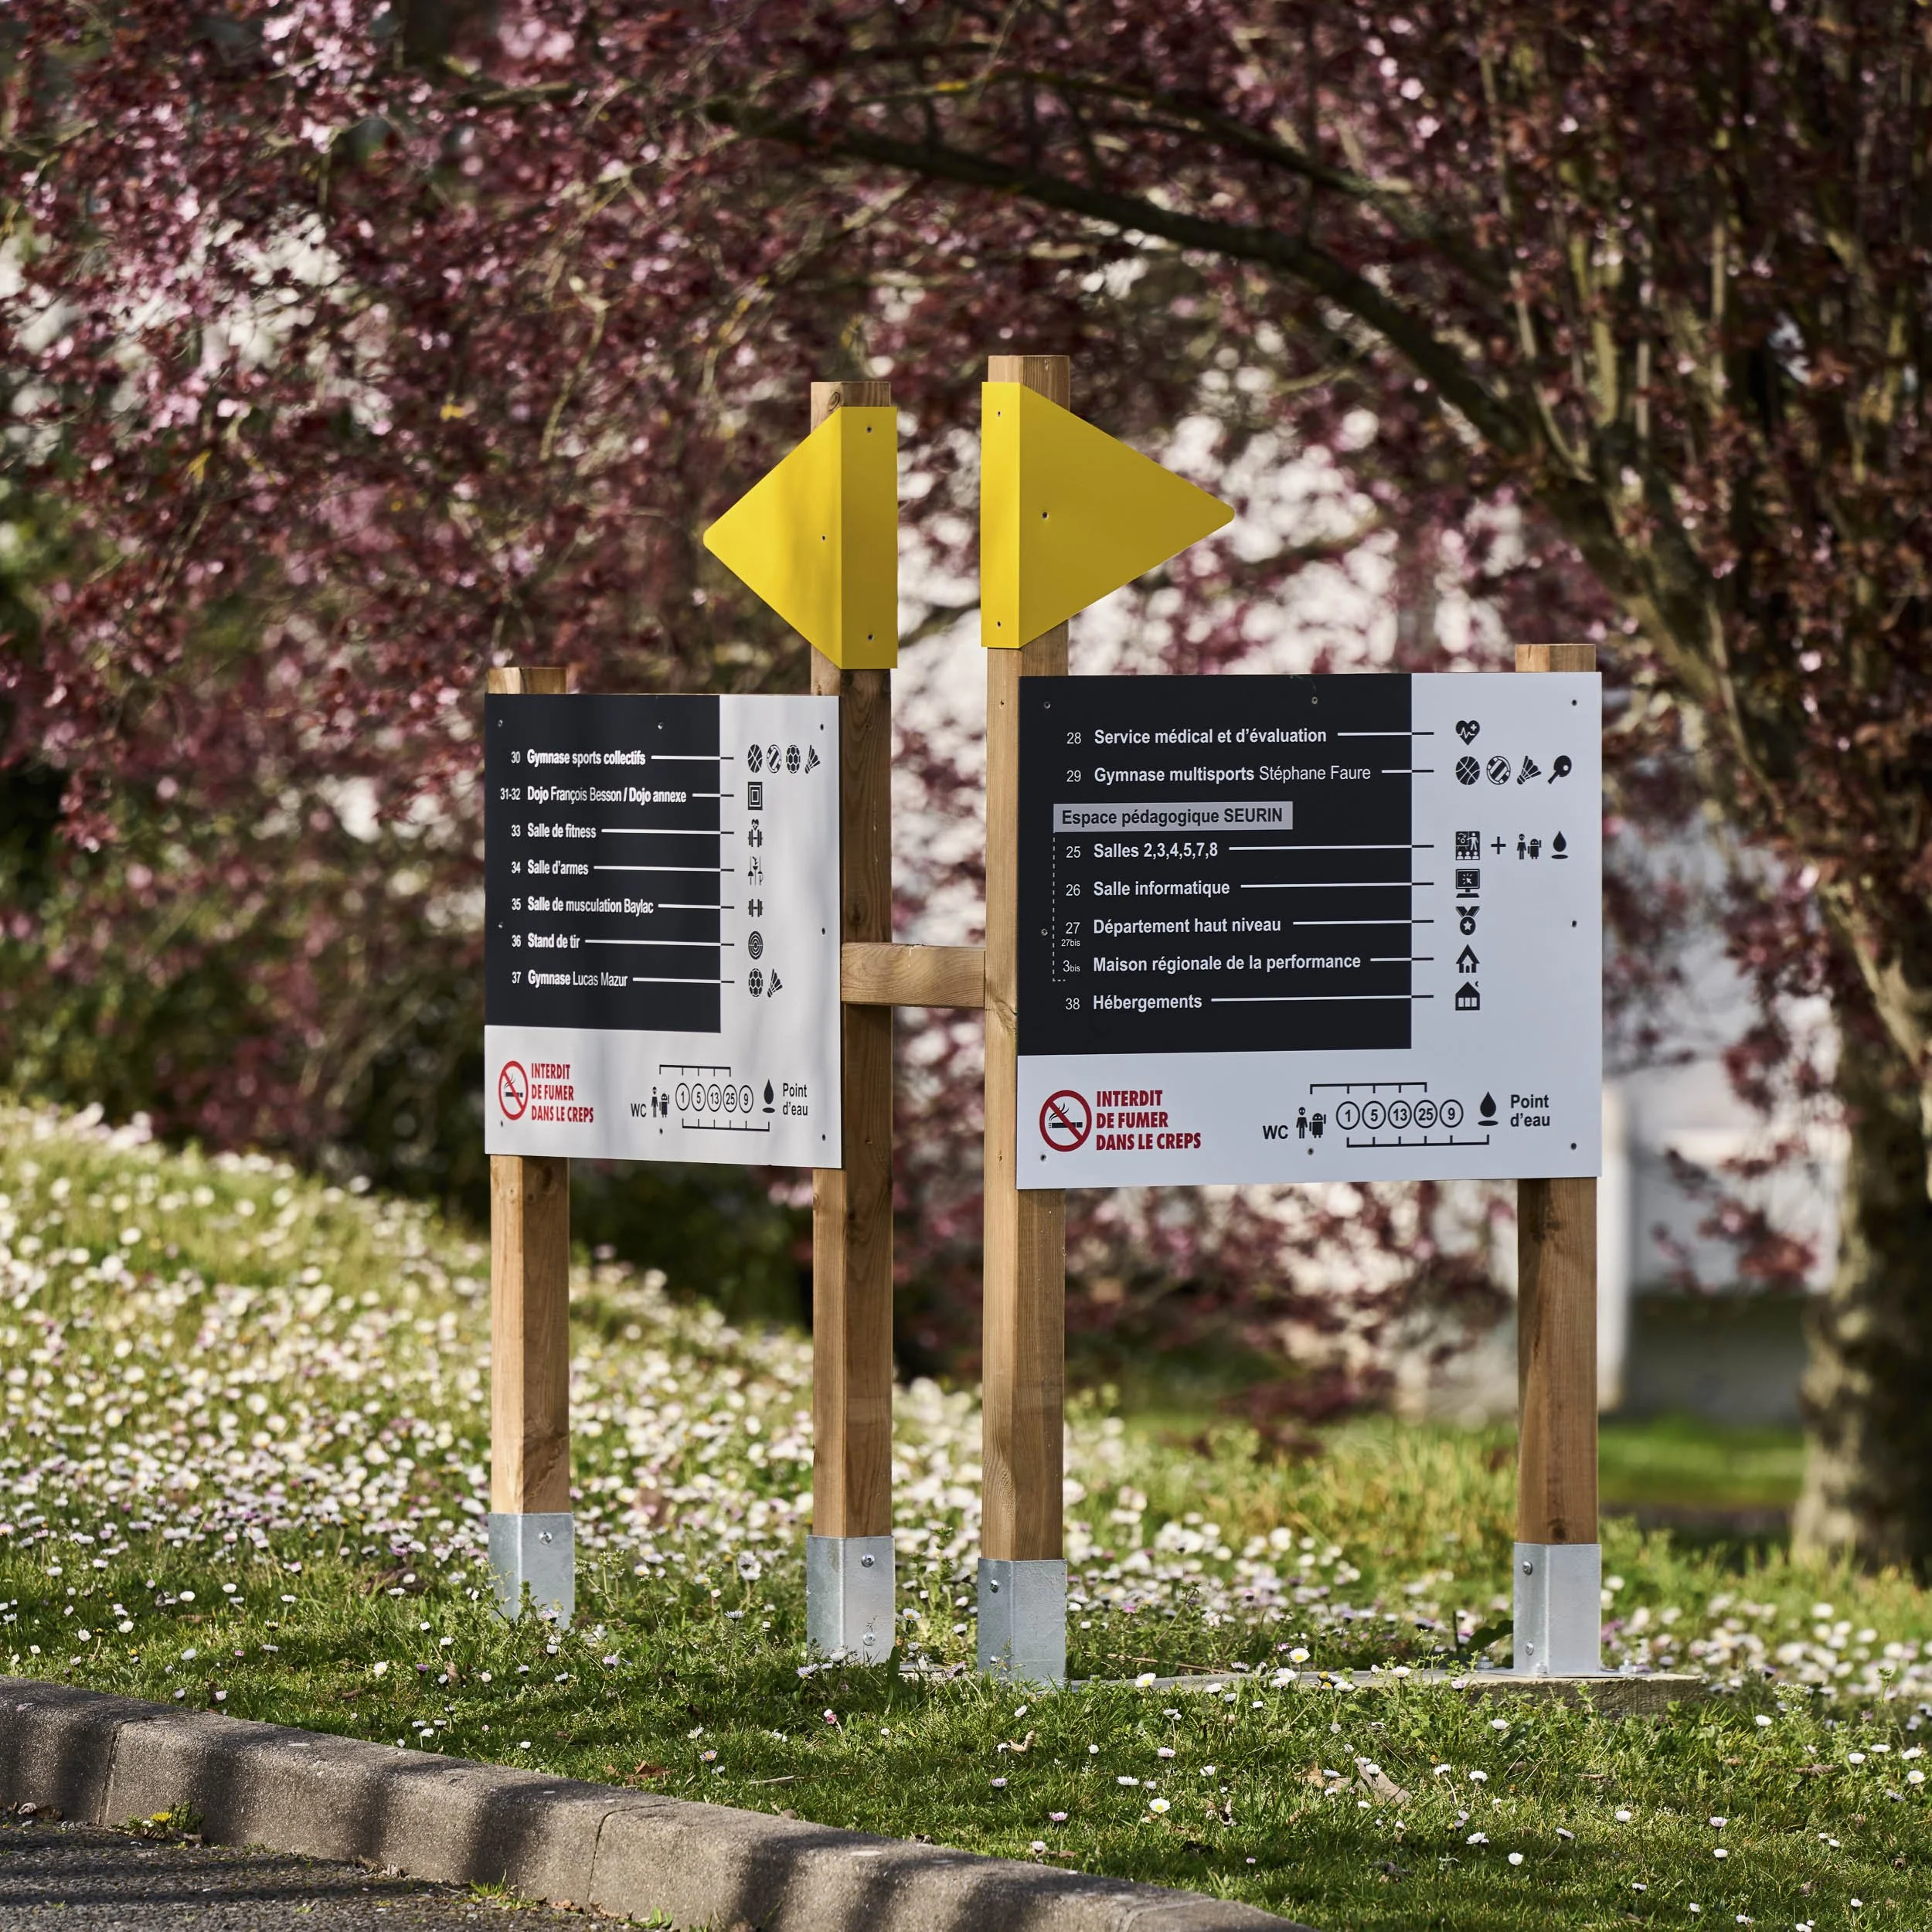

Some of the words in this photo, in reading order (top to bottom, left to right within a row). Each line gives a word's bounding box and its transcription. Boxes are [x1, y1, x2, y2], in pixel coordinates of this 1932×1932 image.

[1066, 732, 1082, 744] 28
[1094, 729, 1151, 744] Service
[1155, 728, 1213, 743] médical
[1217, 729, 1232, 743] et
[511, 750, 521, 764] 30
[526, 748, 570, 768] Gymnase
[571, 750, 602, 768] sports
[603, 750, 646, 766] collectifs
[1066, 770, 1081, 783] 29
[1094, 767, 1165, 786] Gymnase
[1169, 766, 1255, 784] multisports
[1259, 765, 1326, 784] Stéphane
[1331, 765, 1371, 780] Faure
[500, 787, 521, 801] 31-32
[527, 785, 549, 804] Dojo
[550, 785, 588, 804] François
[589, 787, 622, 802] Besson
[623, 787, 628, 802] /
[628, 787, 651, 806] Dojo
[652, 791, 687, 803] annexe
[1062, 809, 1117, 828] Espace
[1121, 808, 1219, 828] pédagogique
[1223, 808, 1283, 823] SEURIN
[511, 824, 521, 838] 33
[527, 822, 550, 838] Salle
[551, 823, 564, 838] de
[564, 822, 597, 838] fitness
[1066, 845, 1081, 859] 25
[1094, 842, 1139, 859] Salles
[1143, 842, 1218, 860] 2,3,4,5,7,8
[511, 861, 522, 874] 34
[527, 859, 550, 875] Salle
[1066, 883, 1081, 896] 26
[1094, 881, 1131, 896] Salle
[1135, 879, 1230, 898] informatique
[511, 897, 522, 911] 35
[527, 896, 551, 912] Salle
[552, 896, 564, 912] de
[565, 897, 622, 913] musculation
[624, 898, 655, 917] Baylac
[1065, 921, 1080, 934] 27
[1094, 918, 1190, 937] Département
[1194, 917, 1228, 933] haut
[1232, 917, 1281, 932] niveau
[512, 934, 522, 947] 36
[527, 932, 555, 948] Stand
[556, 934, 569, 949] de
[569, 934, 581, 949] tir
[1094, 957, 1148, 972] Maison
[1152, 955, 1222, 975] régionale
[1226, 954, 1245, 970] de
[1249, 954, 1262, 970] la
[1267, 954, 1361, 973] performance
[512, 971, 522, 984] 37
[527, 969, 571, 988] Gymnase
[572, 971, 599, 986] Lucas
[600, 971, 628, 987] Mazur
[1065, 997, 1080, 1010] 38
[1093, 994, 1202, 1013] Hébergements
[531, 1063, 571, 1080] INTERDIT
[531, 1083, 543, 1100] DE
[544, 1084, 574, 1101] FUMER
[680, 1090, 685, 1104] 1
[696, 1091, 702, 1104] 5
[710, 1091, 719, 1105] 13
[726, 1092, 736, 1106] 25
[743, 1093, 749, 1106] 9
[782, 1082, 808, 1098] Point
[1097, 1090, 1163, 1107] INTERDIT
[630, 1103, 647, 1118] WC
[1510, 1094, 1549, 1109] Point
[531, 1104, 554, 1121] DANS
[556, 1106, 566, 1122] LE
[566, 1106, 594, 1124] CREPS
[1096, 1112, 1114, 1129] DE
[1117, 1111, 1169, 1129] FUMER
[1345, 1109, 1351, 1123] 1
[1370, 1108, 1379, 1122] 5
[1393, 1107, 1408, 1121] 13
[1418, 1107, 1434, 1121] 25
[1447, 1107, 1456, 1121] 9
[1262, 1124, 1289, 1140] WC
[1096, 1133, 1135, 1151] DANS
[1138, 1133, 1154, 1150] LE
[1156, 1132, 1202, 1150] CREPS
